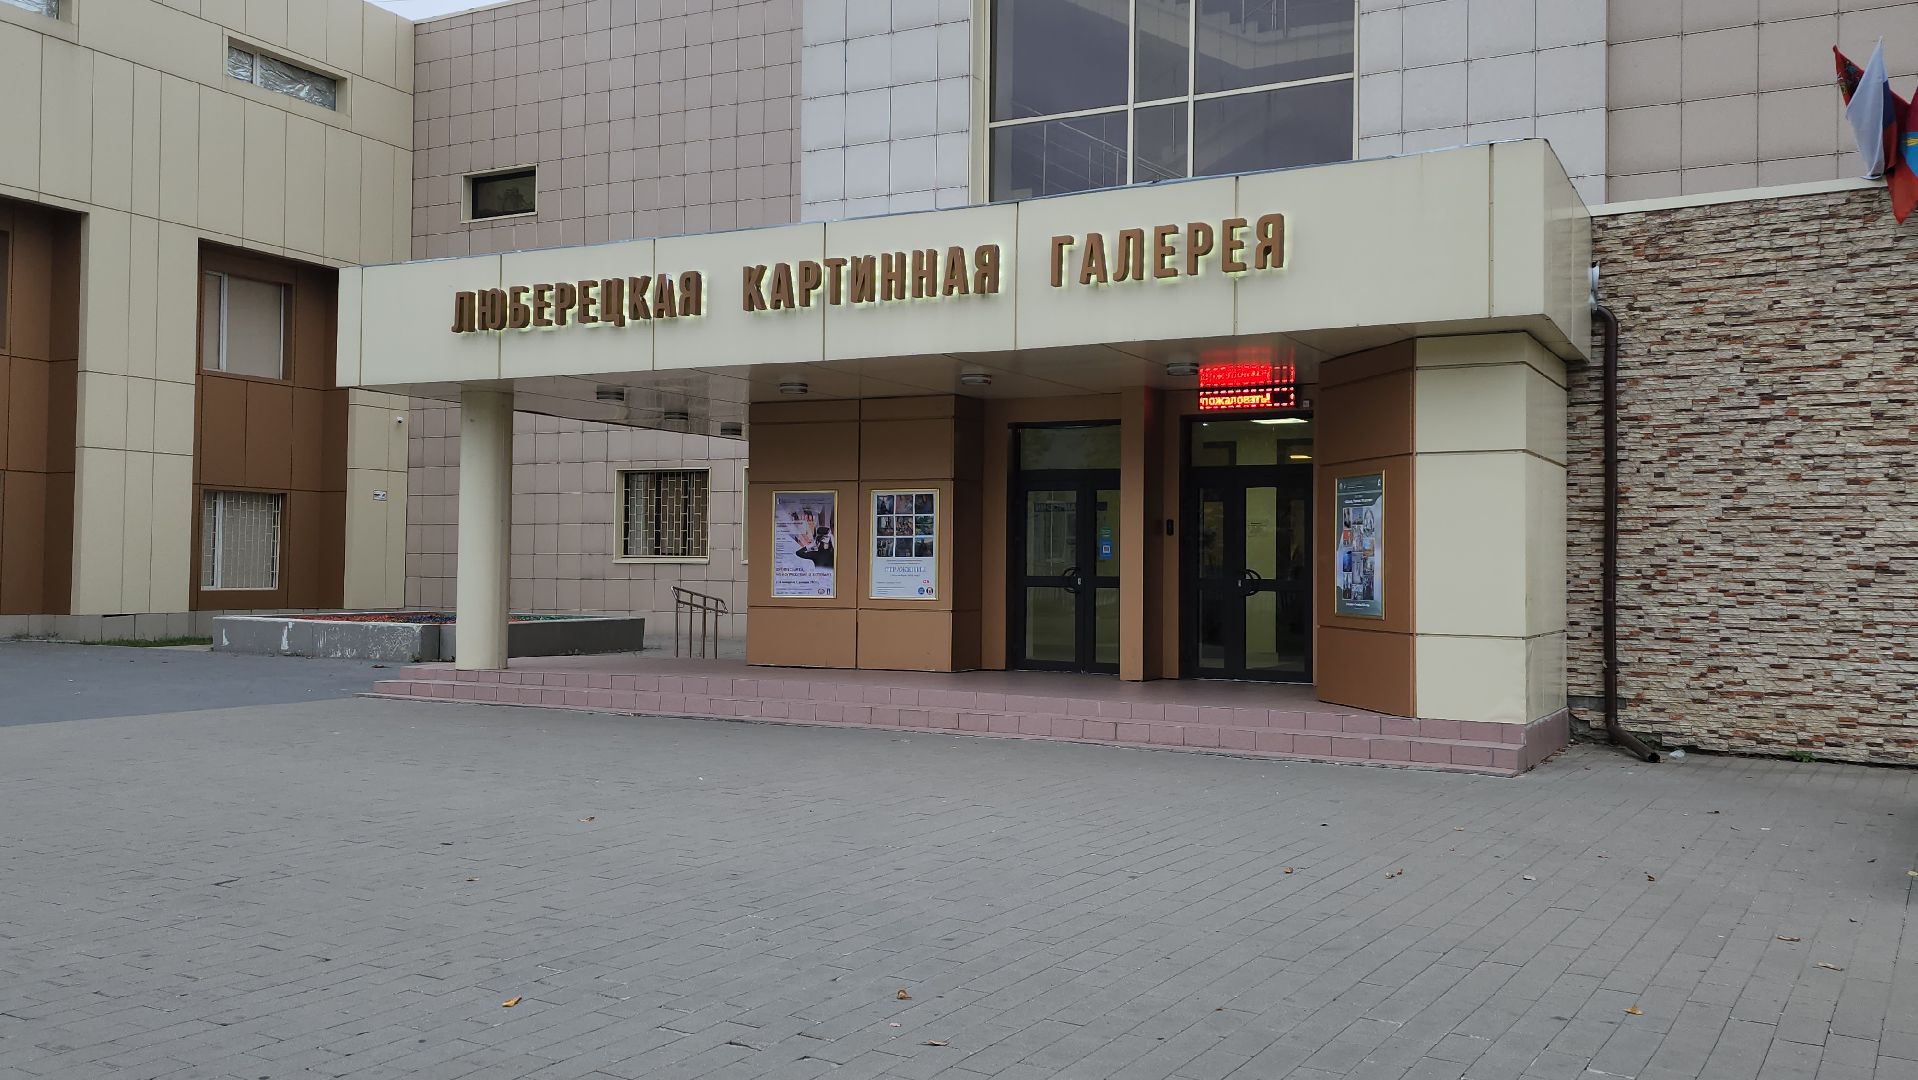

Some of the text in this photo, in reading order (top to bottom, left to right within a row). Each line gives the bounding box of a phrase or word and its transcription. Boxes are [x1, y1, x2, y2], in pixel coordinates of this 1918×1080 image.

[451, 213, 1285, 334] ЛЮБЕРЕЦКАЯ КАРТИННАЯ ГАЛЕРЕЯ
[1201, 392, 1271, 406] пожаловать!
